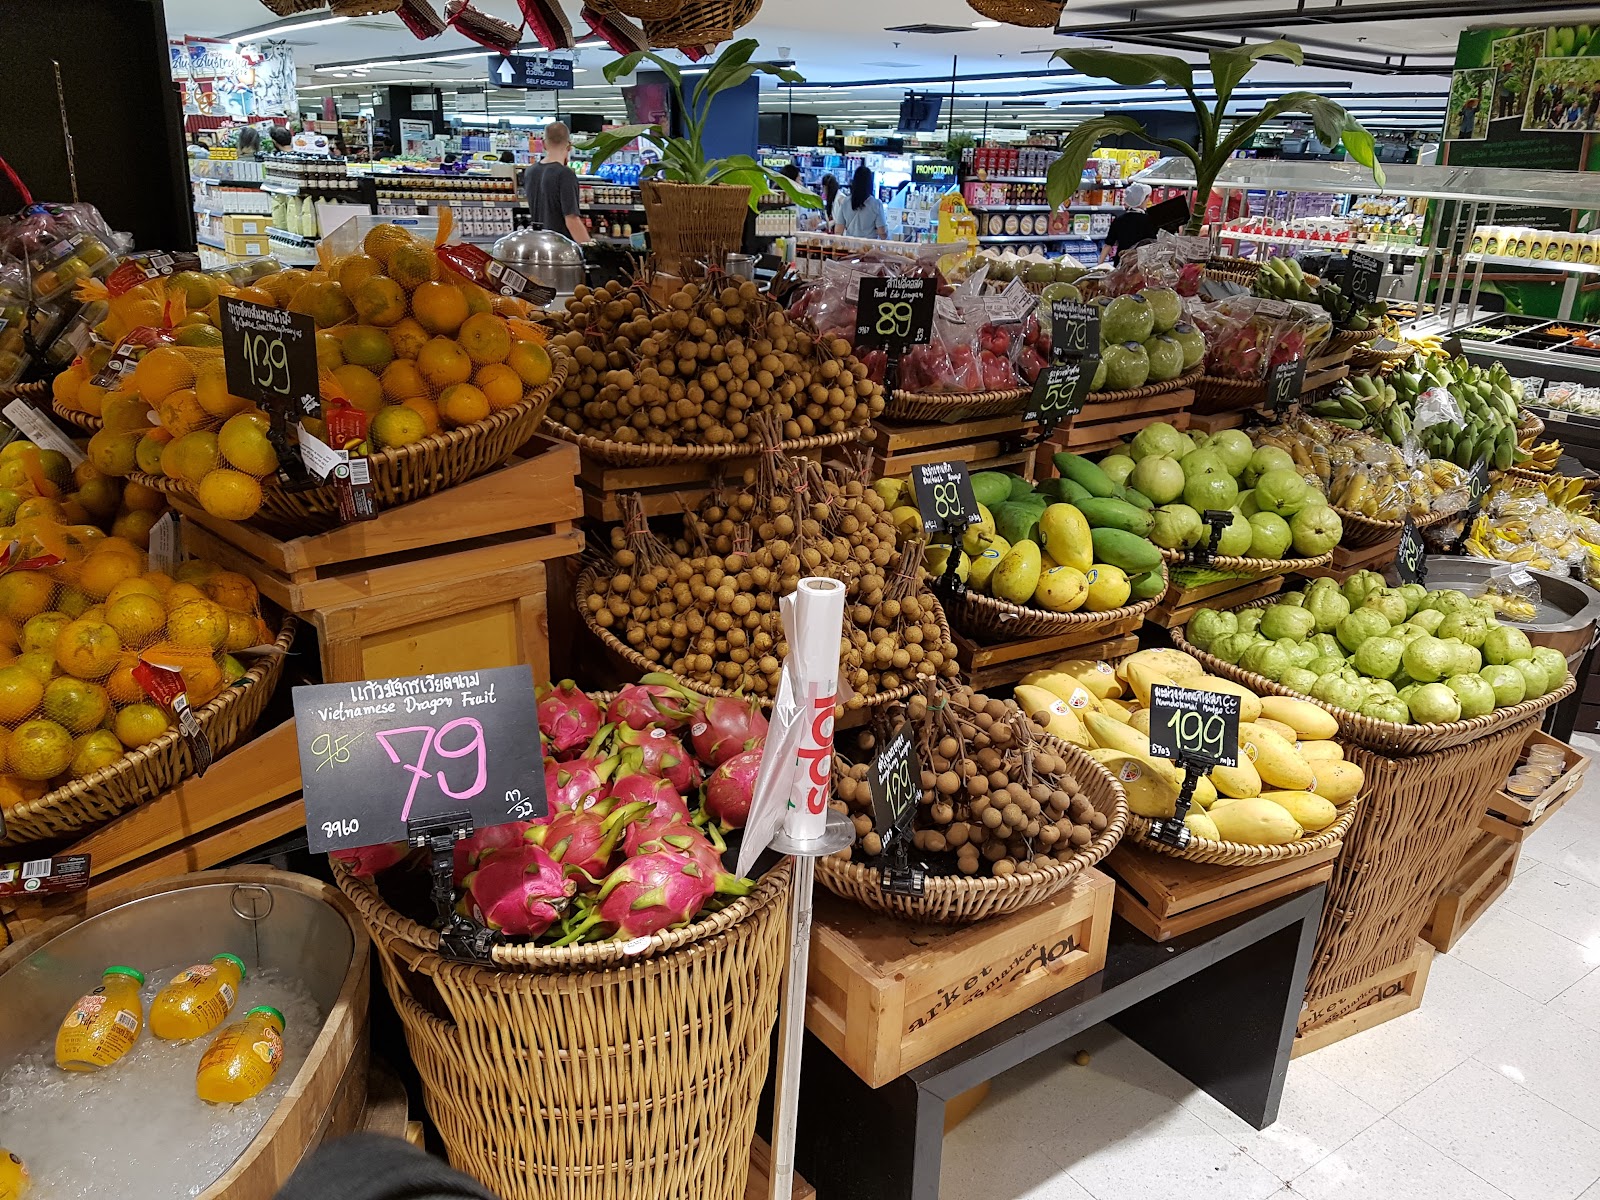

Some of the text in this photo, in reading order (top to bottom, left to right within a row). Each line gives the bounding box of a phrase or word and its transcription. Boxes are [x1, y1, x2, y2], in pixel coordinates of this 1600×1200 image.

[540, 79, 569, 87] CHECKOUT
[916, 165, 954, 175] PROMOTION
[1352, 269, 1368, 293] 65
[875, 301, 913, 337] 89
[243, 330, 291, 395] 139
[403, 695, 453, 716] Dragon
[461, 683, 497, 708] Fruit
[1167, 708, 1226, 759] 199
[1151, 743, 1171, 757] 5703
[375, 716, 488, 822] 79
[321, 818, 360, 839] 8960
